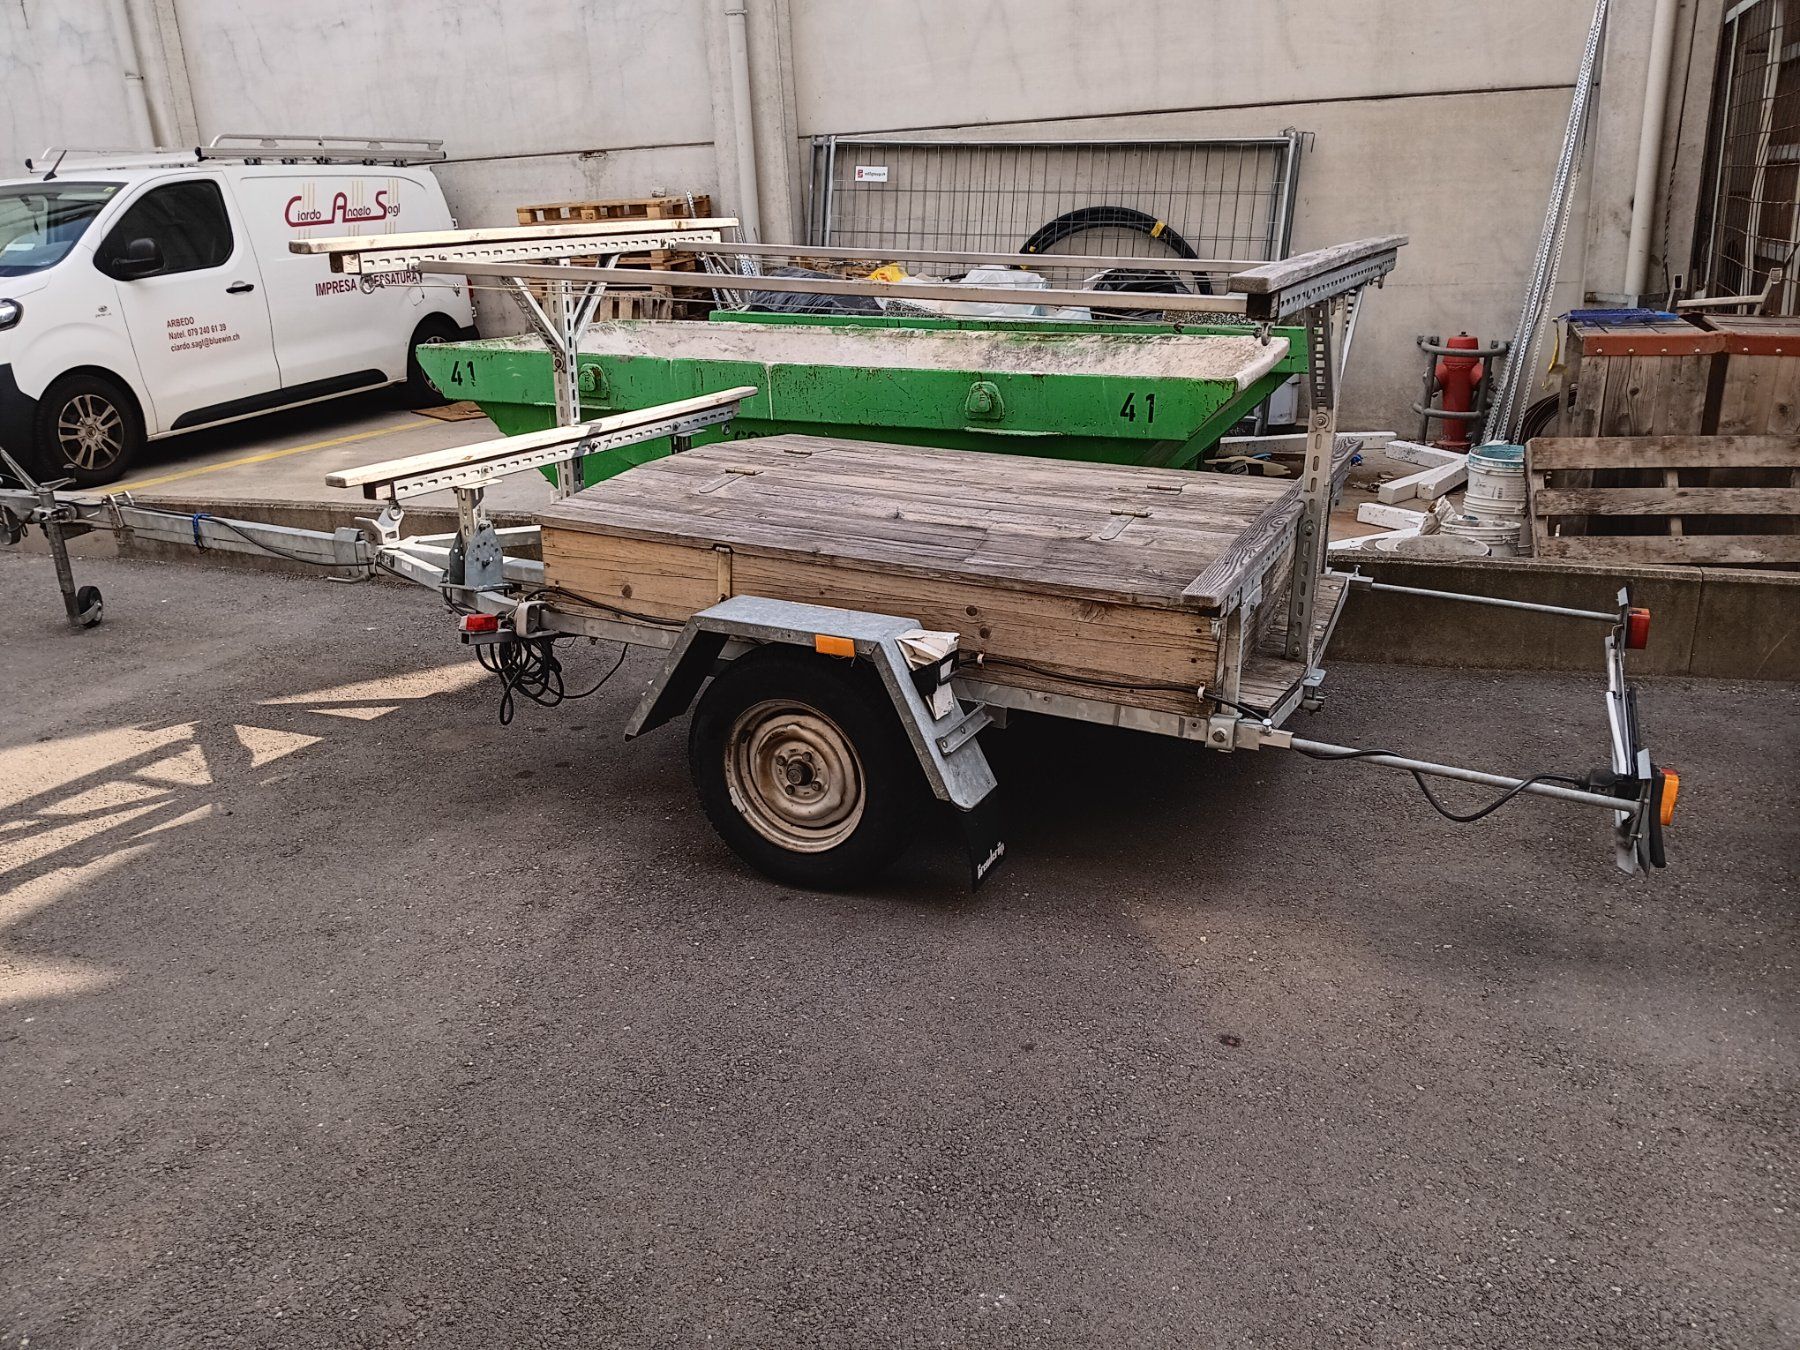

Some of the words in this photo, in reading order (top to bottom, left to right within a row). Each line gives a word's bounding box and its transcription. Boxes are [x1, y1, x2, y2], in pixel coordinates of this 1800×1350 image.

[285, 196, 323, 227] Ciardo
[331, 192, 371, 223] Angelo
[375, 190, 400, 220] Sagl
[315, 279, 357, 296] IMPRESA
[368, 271, 418, 286] ESSATURA
[167, 316, 195, 328] ARBEDO
[187, 327, 199, 337] 079
[199, 325, 211, 335] 240
[170, 333, 241, 352] ciardo.sagl@bluewin.ch
[451, 361, 476, 387] 41
[1120, 392, 1156, 424] 41
